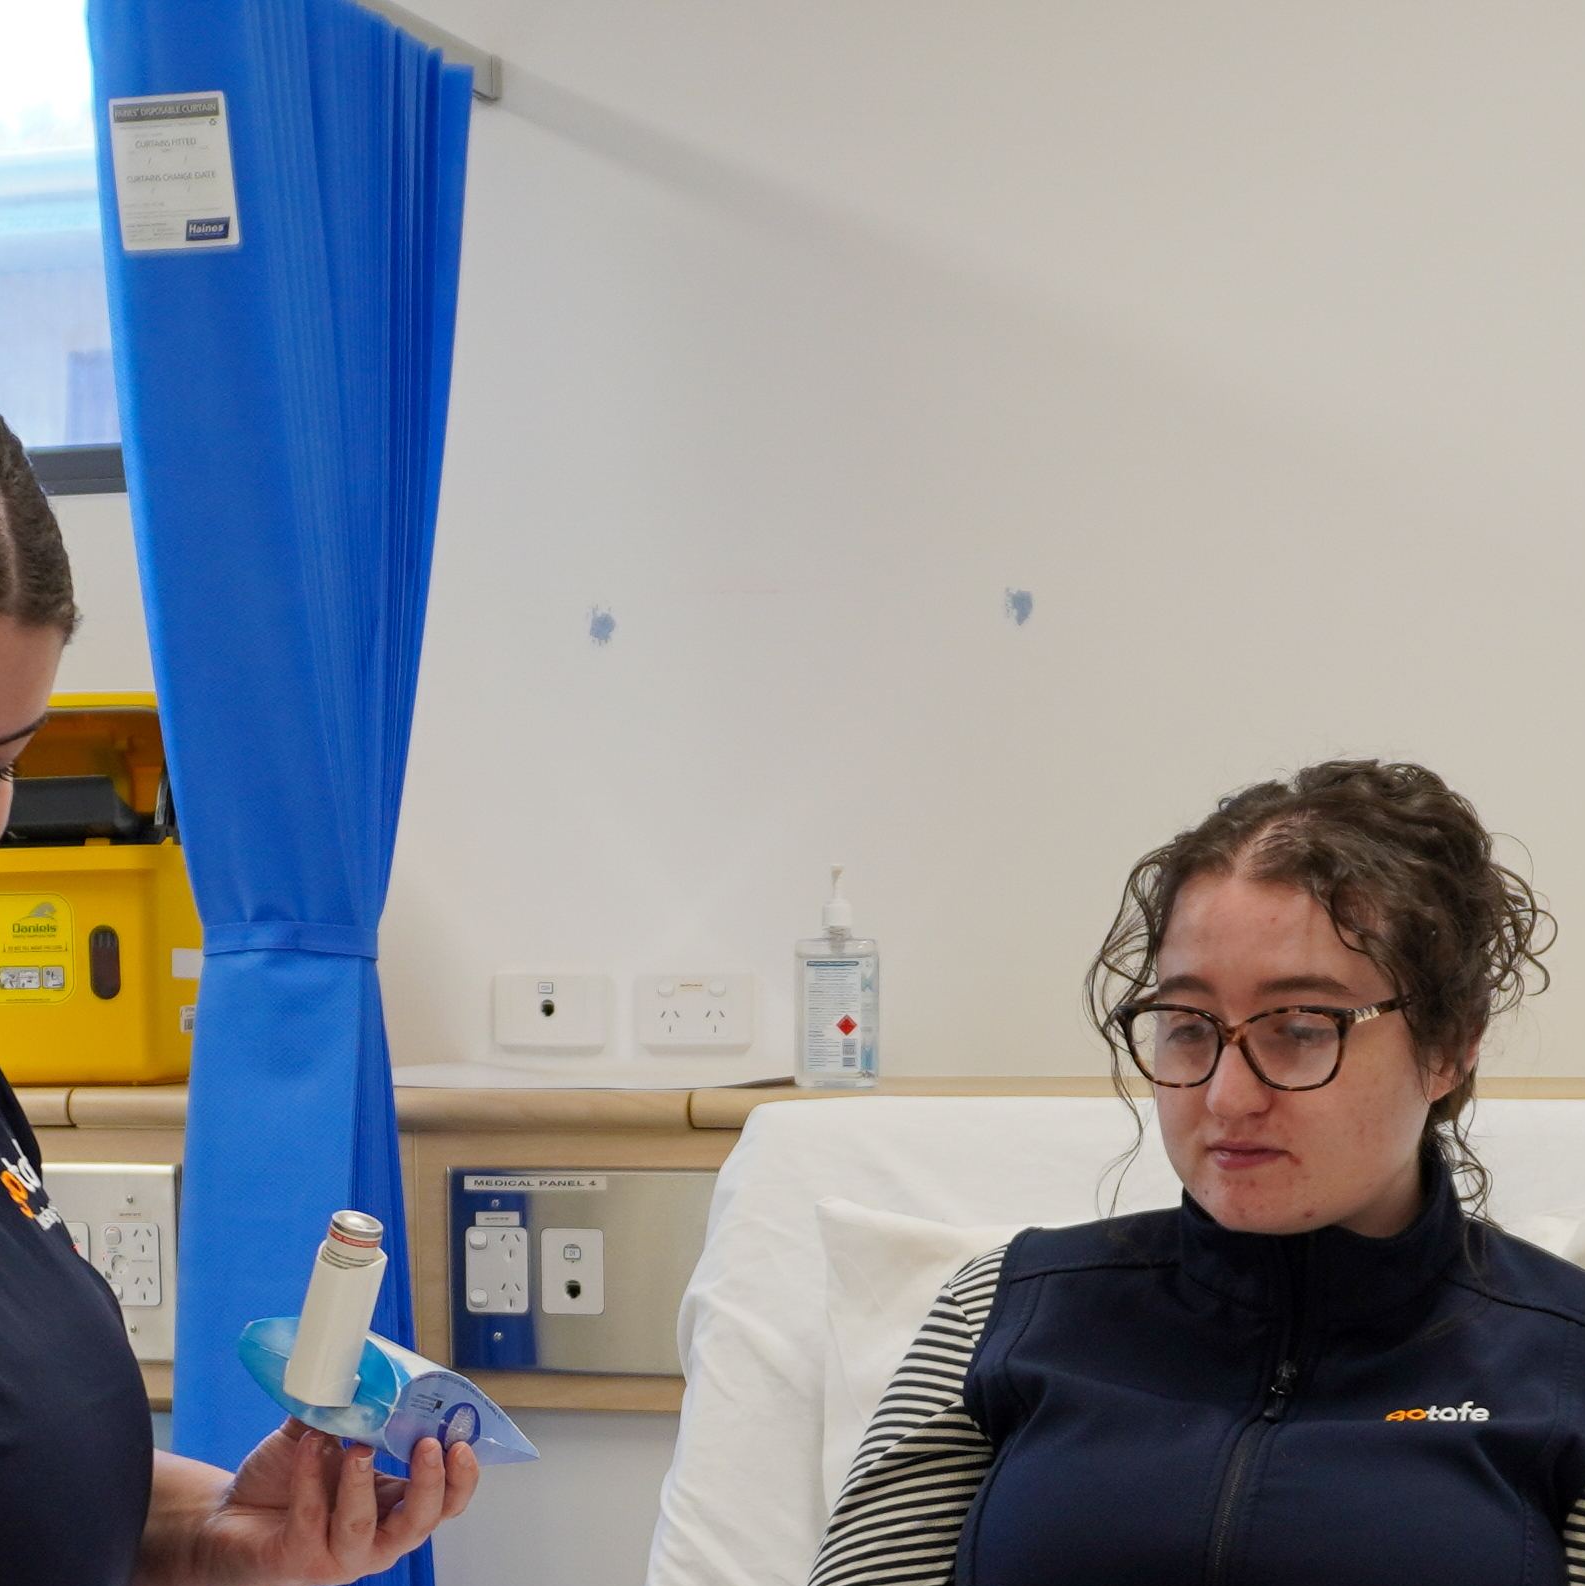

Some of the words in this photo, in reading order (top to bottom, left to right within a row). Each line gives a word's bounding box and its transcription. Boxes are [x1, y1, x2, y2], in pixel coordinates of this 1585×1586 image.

[182, 103, 217, 113] CURTAIN
[135, 139, 171, 149] CURTAINS
[126, 174, 161, 184] CURTAINS
[194, 170, 216, 180] DATE
[188, 223, 225, 234] Haines
[12, 923, 57, 934] Daniels
[473, 1179, 535, 1187] MEDICAL
[538, 1179, 585, 1187] PANEL
[588, 1179, 597, 1187] 4
